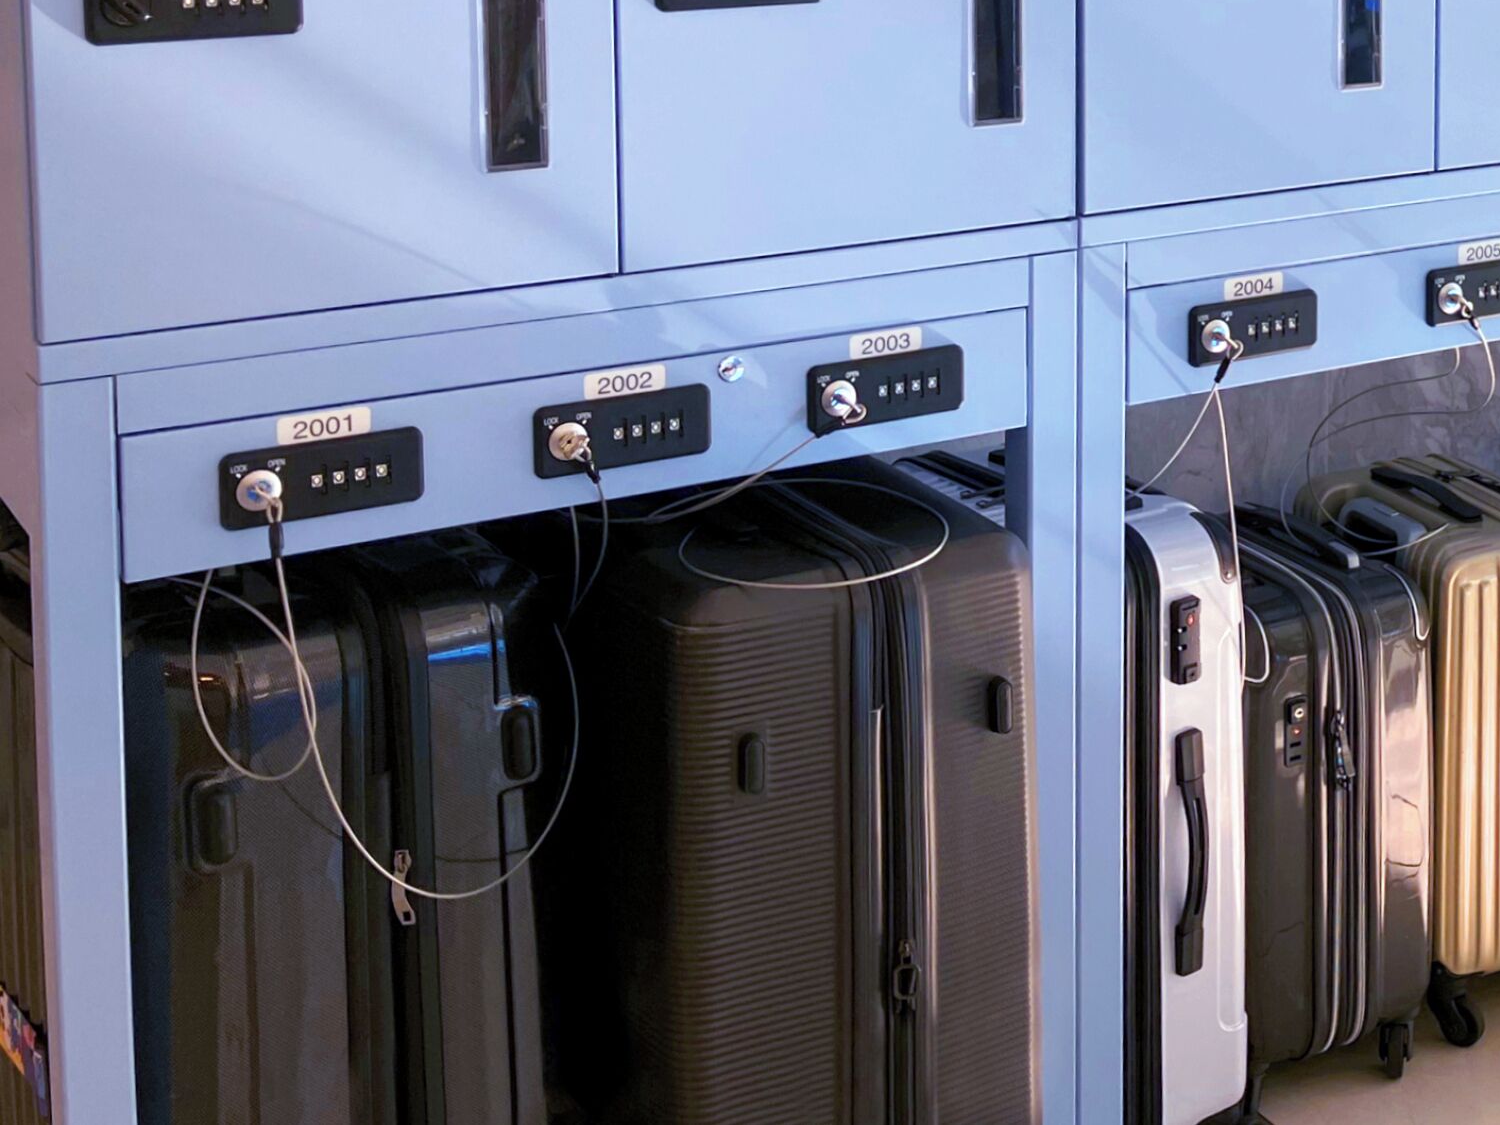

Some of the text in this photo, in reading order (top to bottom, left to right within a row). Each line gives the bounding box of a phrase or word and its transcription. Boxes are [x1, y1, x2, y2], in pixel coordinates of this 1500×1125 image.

[1233, 277, 1274, 297] 2004
[861, 333, 911, 355] 2003
[597, 371, 653, 395] 2002
[544, 417, 559, 425] LOCK
[576, 412, 592, 420] OPEN
[293, 414, 353, 440] 2001
[230, 464, 248, 474] LOCK
[267, 459, 286, 467] OPEN
